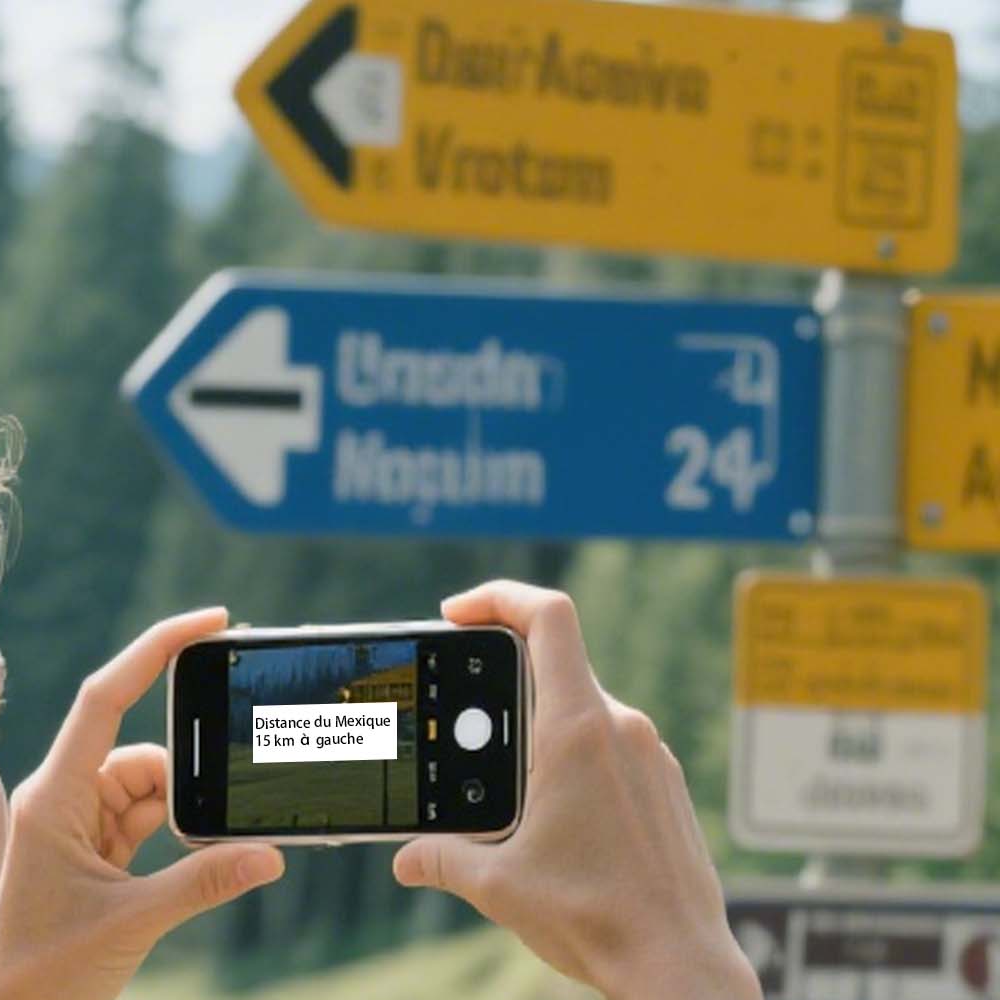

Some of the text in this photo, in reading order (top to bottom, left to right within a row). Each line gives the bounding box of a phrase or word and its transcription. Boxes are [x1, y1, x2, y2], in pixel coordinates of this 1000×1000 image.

[255, 714, 391, 730] Distance du Mexique
[255, 732, 364, 749] 15 km à gauche
